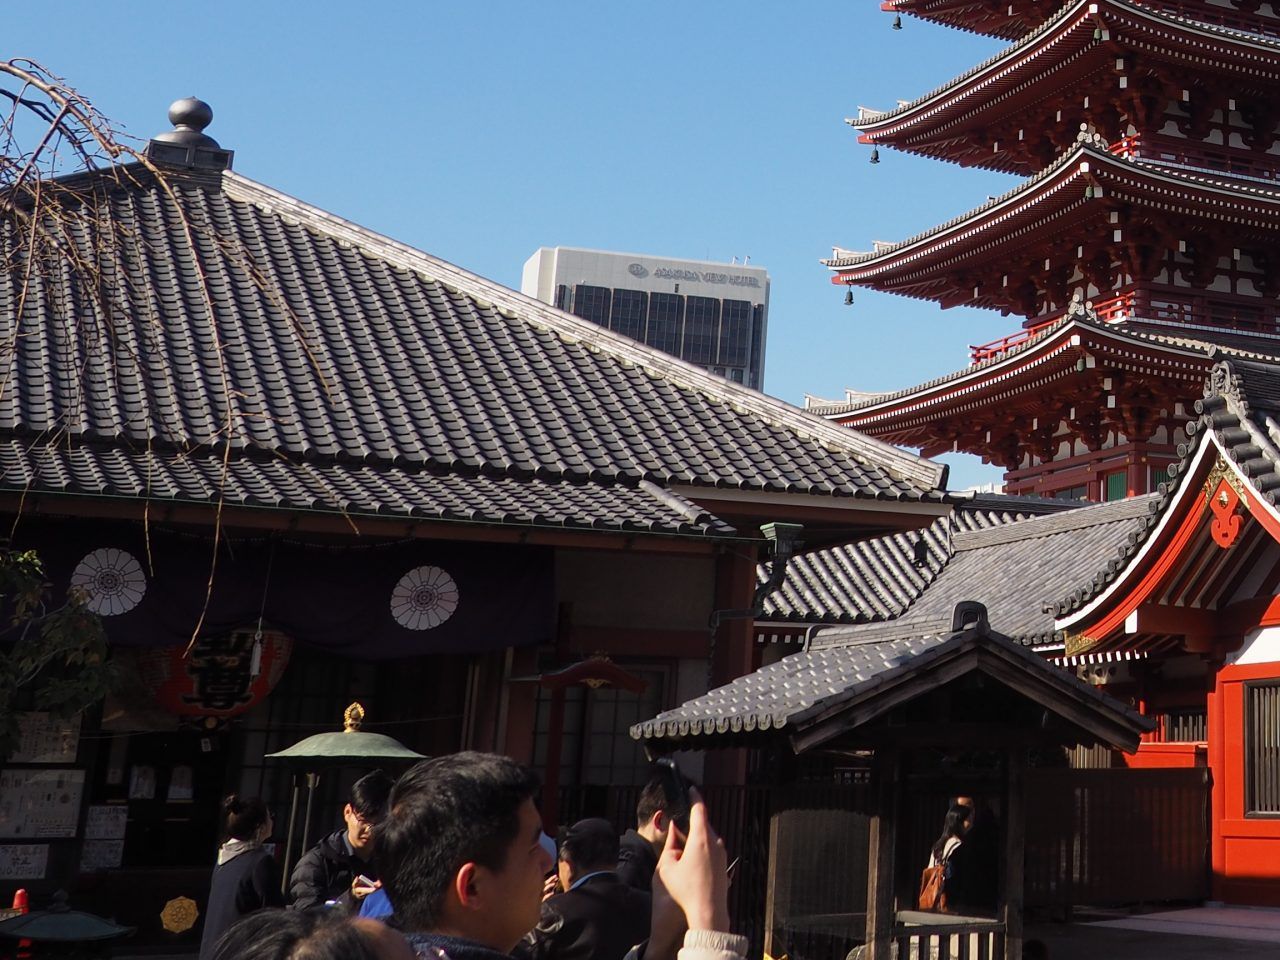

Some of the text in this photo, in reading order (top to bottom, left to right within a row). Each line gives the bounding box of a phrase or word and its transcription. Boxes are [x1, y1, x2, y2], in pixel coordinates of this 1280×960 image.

[654, 266, 761, 288] ASAKUSA VIEW HOTEL
